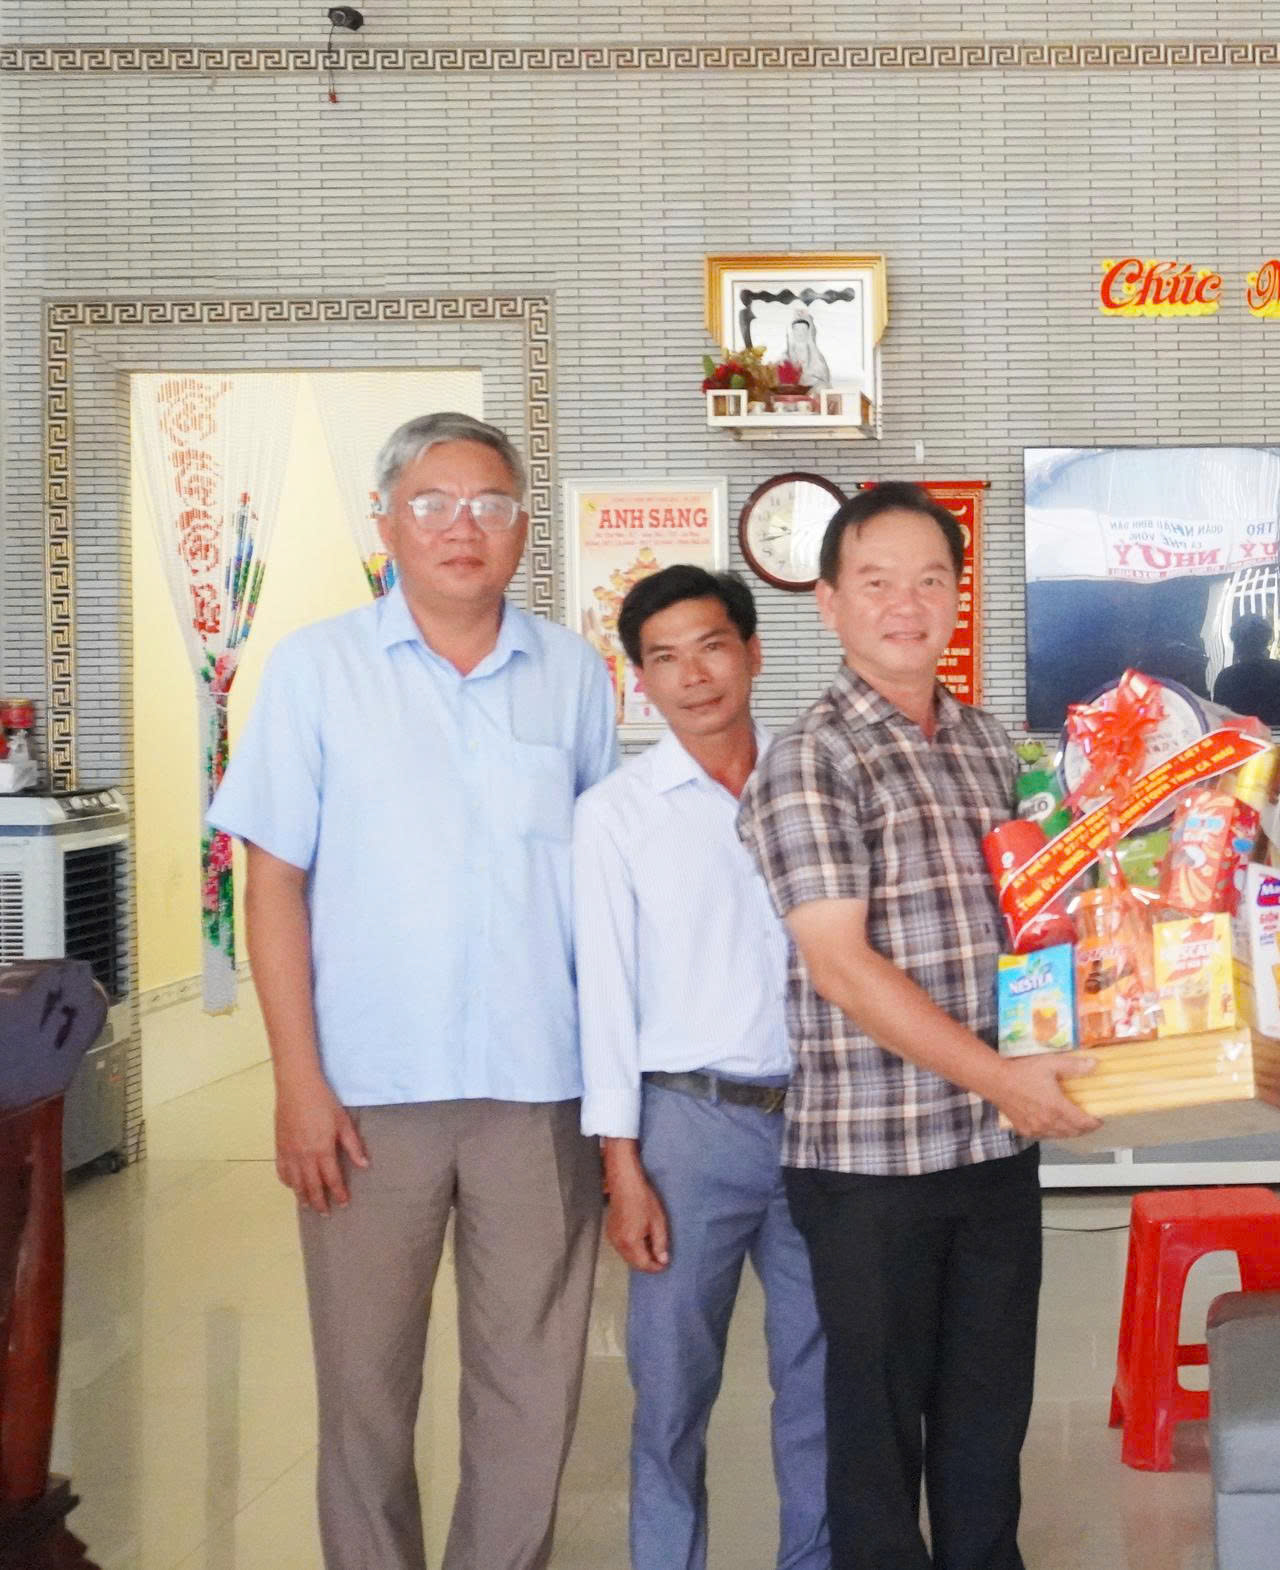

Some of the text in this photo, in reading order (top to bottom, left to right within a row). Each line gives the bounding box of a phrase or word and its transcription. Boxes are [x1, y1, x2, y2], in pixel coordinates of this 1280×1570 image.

[1101, 257, 1222, 309] Chúc
[599, 507, 709, 528] ANH SANG
